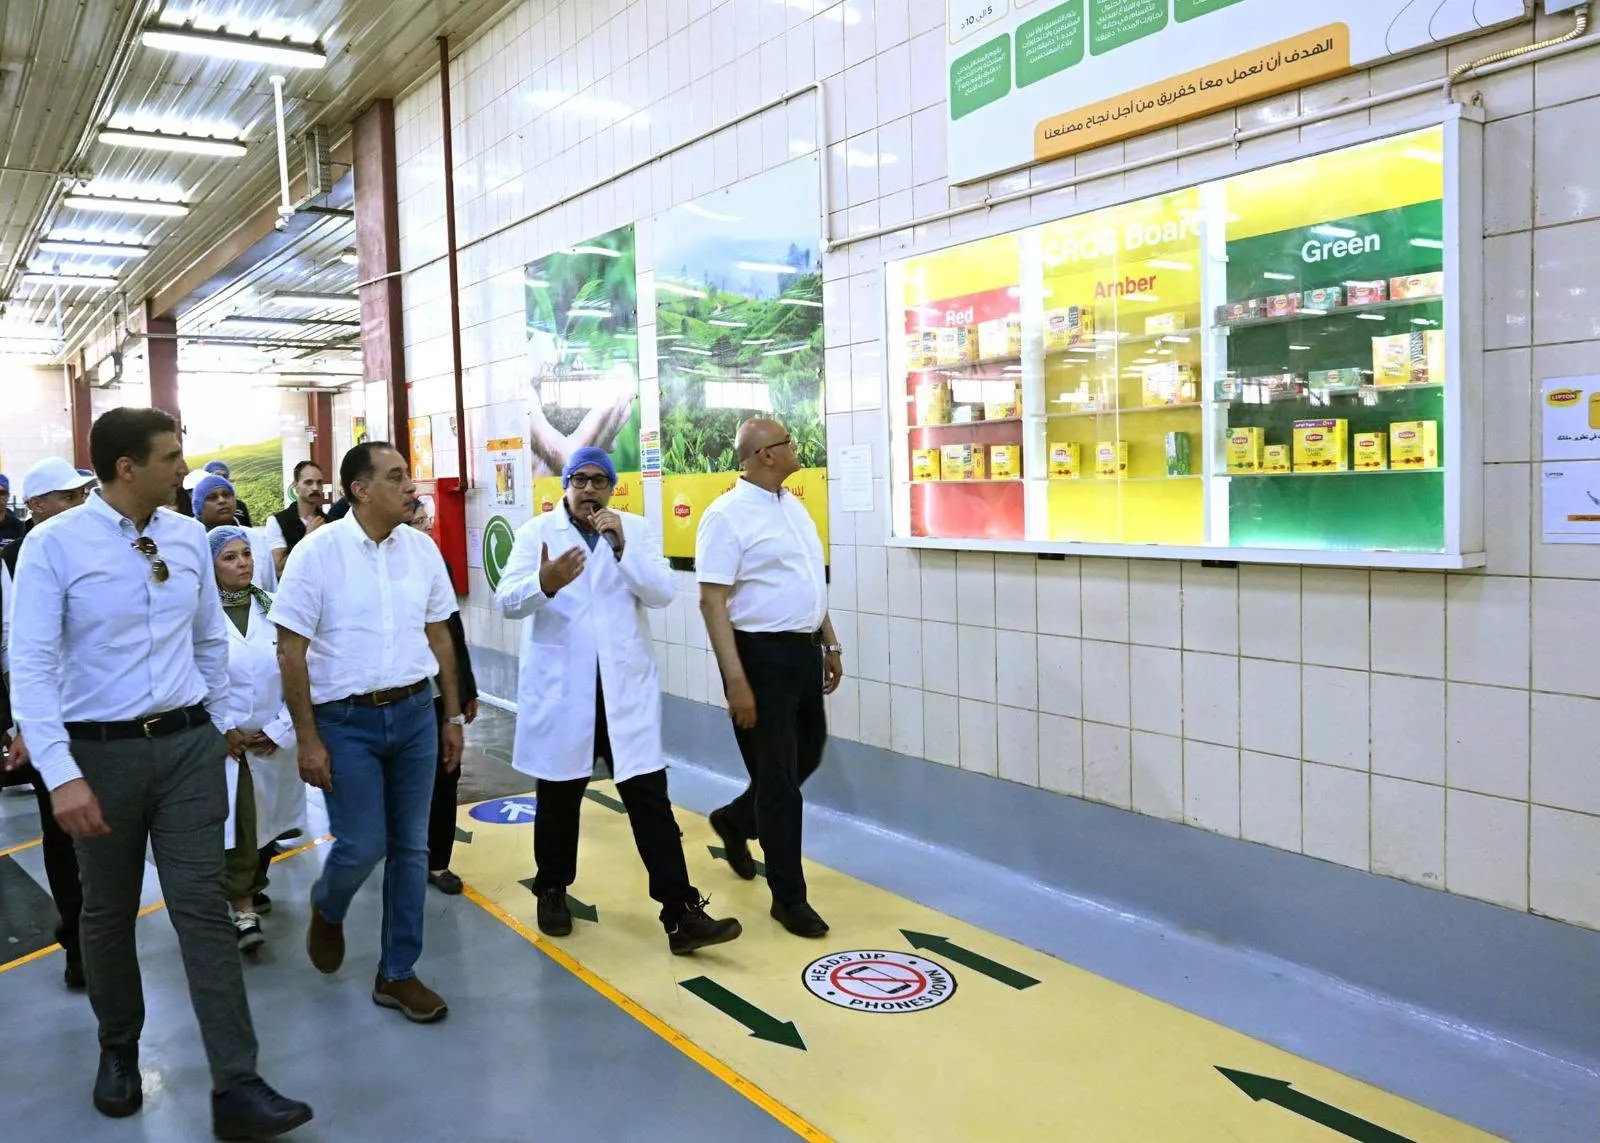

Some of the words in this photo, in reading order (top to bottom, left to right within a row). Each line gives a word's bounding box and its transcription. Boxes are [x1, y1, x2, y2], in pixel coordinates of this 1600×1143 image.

[965, 15, 975, 25] 10
[987, 5, 993, 15] 5
[1266, 51, 1281, 72] أن
[1284, 38, 1333, 64] الهدف
[1226, 60, 1263, 84] نعمل
[1156, 83, 1196, 107] كفريق
[1111, 99, 1134, 120] أجل
[1135, 99, 1154, 113] من
[1085, 110, 1110, 129] نجاح
[1044, 121, 1083, 140] مصنعنا
[1125, 215, 1203, 250] Boar
[1301, 233, 1381, 263] Green
[1095, 274, 1157, 299] Amber
[945, 308, 974, 325] Red
[675, 506, 690, 516] Lipton
[811, 955, 852, 982] HEADS
[849, 996, 934, 1010] PHONES
[925, 969, 947, 997] DOWN
